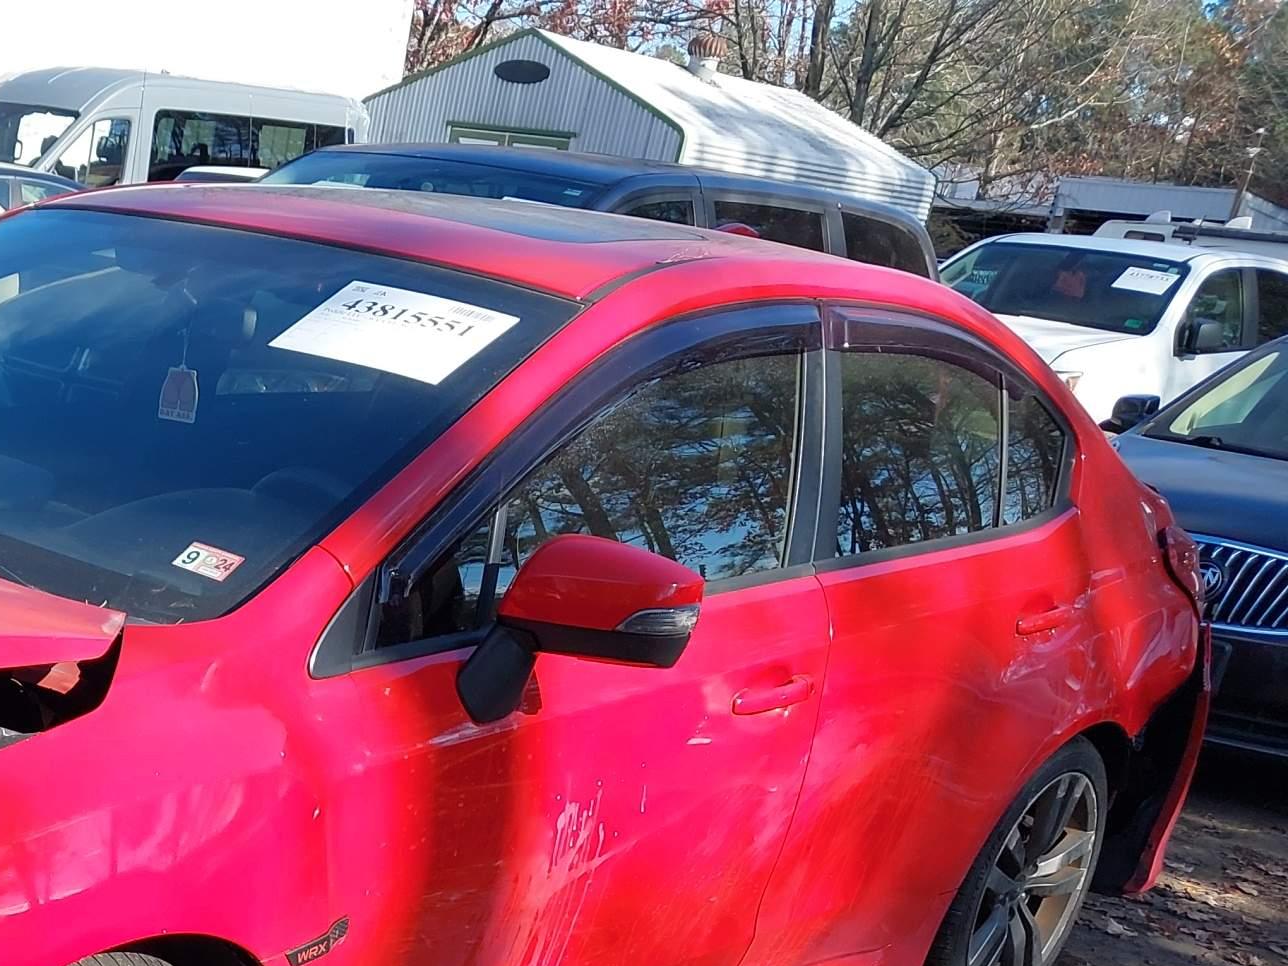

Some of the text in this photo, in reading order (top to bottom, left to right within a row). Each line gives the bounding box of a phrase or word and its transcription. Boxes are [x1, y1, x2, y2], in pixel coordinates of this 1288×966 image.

[341, 298, 475, 337] 43815551
[181, 550, 236, 573] 9 24
[296, 941, 329, 963] WRX
